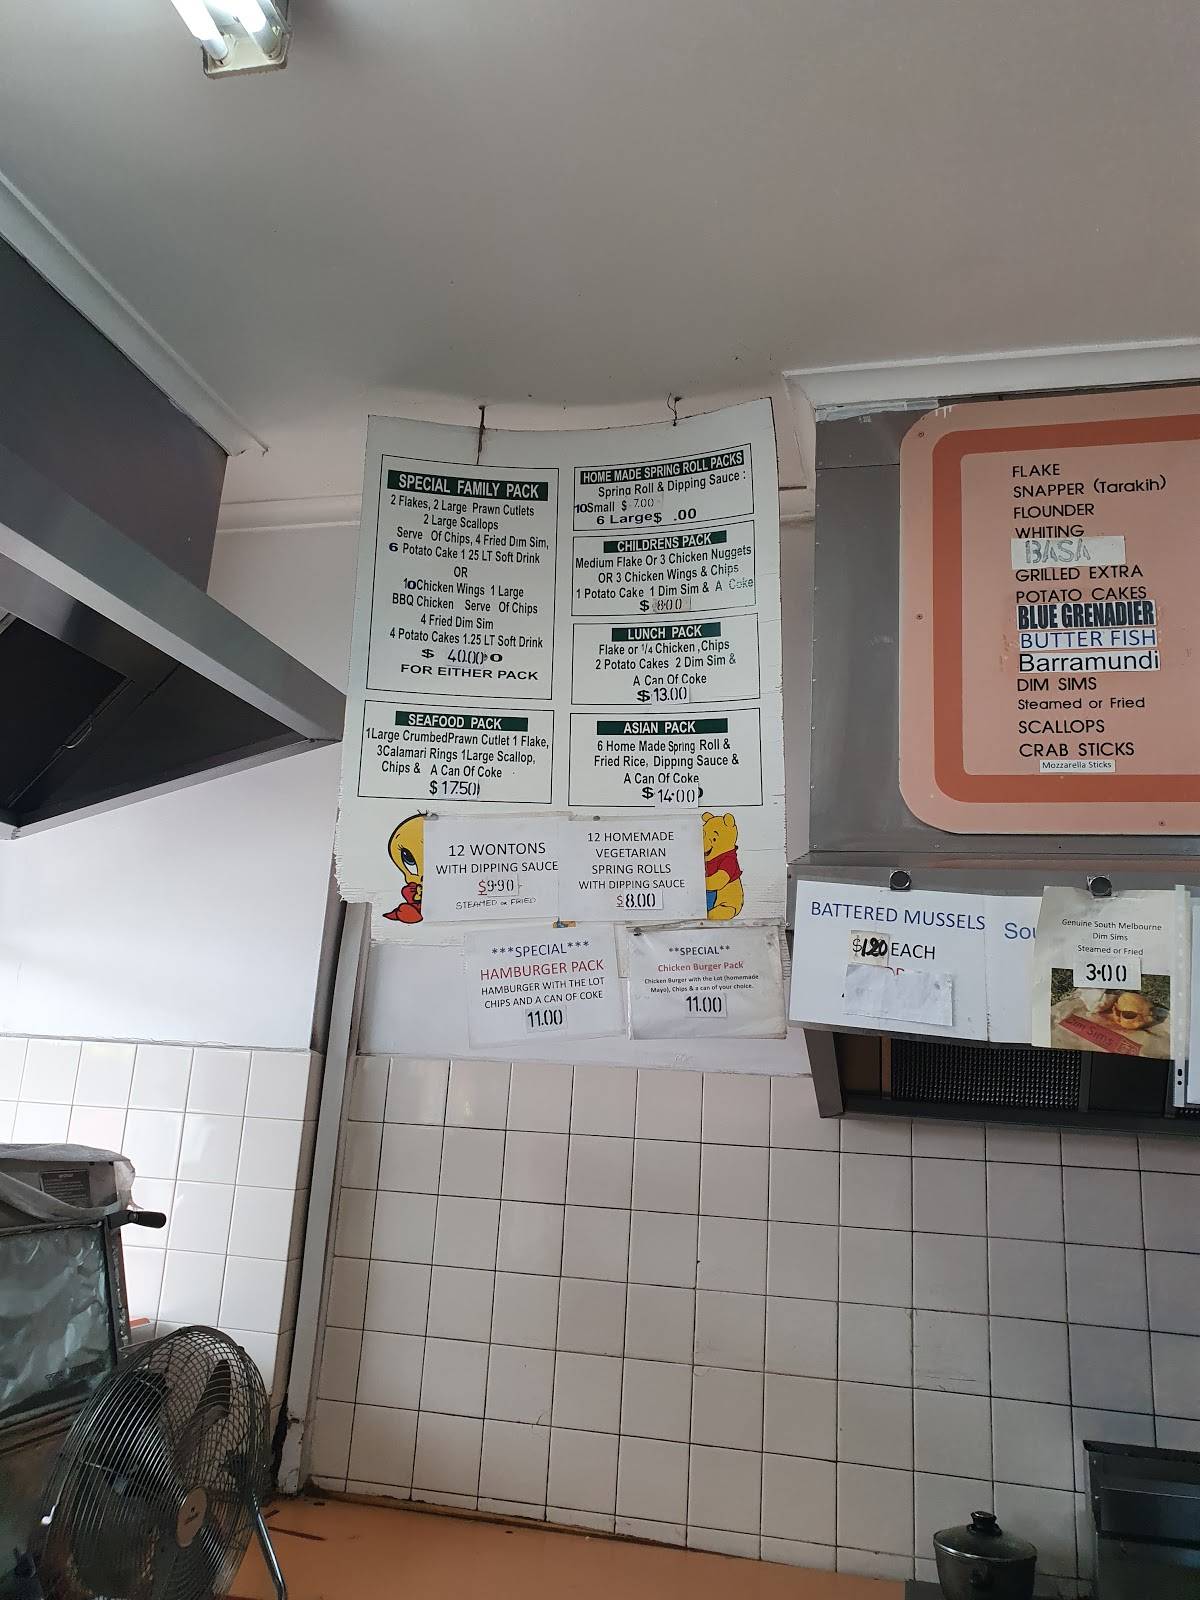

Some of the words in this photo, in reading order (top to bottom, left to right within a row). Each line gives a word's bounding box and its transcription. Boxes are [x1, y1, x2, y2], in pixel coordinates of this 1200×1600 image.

[583, 470, 611, 483] HOME
[614, 468, 642, 480] MADE
[644, 463, 680, 478] SPRING
[682, 459, 708, 472] ROLL
[710, 452, 742, 468] PACKS
[1013, 464, 1060, 478] FLAKE
[399, 473, 450, 493] SPECIAL
[458, 480, 500, 497] FAMILY
[506, 484, 539, 498] PACK
[635, 483, 653, 495] Roll
[668, 476, 705, 492] Dipping
[709, 472, 740, 485] Sauce
[1014, 483, 1084, 498] SNAPPER
[1094, 474, 1166, 494] (Tarakih)
[442, 500, 467, 514] Large
[473, 503, 500, 514] Prawn
[504, 505, 534, 516] Cutlets
[1014, 503, 1094, 519] FLOUNDER
[432, 515, 457, 529] Large
[460, 517, 498, 532] Scallops
[1015, 524, 1084, 538] WHITING
[397, 527, 422, 539] Serve
[445, 532, 472, 546] Chips,
[484, 535, 506, 547] Fried
[510, 536, 526, 548] Dim
[618, 537, 679, 552] CHILDRENS
[682, 533, 712, 546] PACK
[403, 543, 432, 556] Potato
[436, 547, 457, 559] Cake
[495, 550, 513, 562] Soft
[516, 551, 540, 563] Drink
[575, 557, 613, 568] Medium
[617, 557, 642, 567] Flake
[669, 549, 708, 564] Chicken
[711, 545, 752, 559] Nuggets
[1025, 538, 1091, 564] BASA
[625, 570, 664, 582] Chicken
[667, 568, 697, 581] Wings
[711, 563, 739, 576] Chips
[1016, 567, 1080, 582] GRILLED
[1090, 565, 1143, 579] EXTRA
[457, 583, 485, 598] Wings
[499, 586, 524, 599] Large
[585, 588, 616, 599] Potato
[619, 586, 644, 598] Cake
[658, 585, 677, 596] Dim
[681, 583, 699, 595] Sim
[1016, 589, 1082, 603] POTATO
[1092, 586, 1147, 600] CAKES
[392, 593, 414, 606] BBQ
[417, 596, 453, 609] Chicken
[465, 600, 490, 612] Serve
[512, 602, 538, 616] Chips
[429, 615, 452, 627] Fried
[456, 617, 473, 628] Dim
[476, 618, 493, 629] Sim
[1018, 604, 1058, 629] BLUE
[1062, 600, 1154, 627] GRENADIER
[399, 628, 428, 641] Potato
[432, 631, 459, 643] Cakes
[498, 635, 516, 647] Soft
[519, 637, 543, 648] Drink
[628, 628, 665, 640] LUNCH
[672, 625, 702, 638] PACK
[1021, 631, 1102, 648] BUTTER
[1111, 629, 1155, 646] FISH
[599, 644, 625, 655] Flake
[604, 659, 636, 670] Potato
[639, 658, 669, 669] Cakes
[685, 656, 703, 667] Dim
[707, 654, 725, 665] Sim
[1019, 651, 1159, 671] Barramundi
[401, 664, 432, 674] FOR
[438, 666, 492, 678] EITHER
[498, 670, 538, 680] PACK
[645, 674, 663, 686] Can
[682, 673, 707, 684] Coke
[1018, 679, 1048, 691] DIM
[1058, 677, 1097, 690] SIMS
[1018, 698, 1082, 709] Steamed
[1111, 697, 1145, 708] Fried
[408, 714, 464, 727] SEAFOOD
[471, 717, 501, 729] PACK
[624, 722, 658, 733] ASIAN
[665, 721, 696, 733] PACK
[1019, 720, 1104, 733] SCALLOPS
[481, 734, 509, 746] Cutlet
[521, 736, 549, 748] Flake,
[606, 741, 635, 751] Home
[639, 740, 665, 751] Made
[668, 740, 695, 754] Spring
[700, 739, 720, 750] Roll
[430, 748, 457, 762] Rings
[1020, 743, 1068, 757] CRAB
[1079, 742, 1134, 756] STICKS
[382, 761, 410, 774] Chips
[441, 765, 459, 776] Can
[478, 766, 502, 778] Coke
[595, 756, 620, 766] Fried
[653, 756, 693, 769] Dipping
[697, 755, 728, 766] Sauce
[1089, 761, 1111, 769] Sticks
[635, 773, 654, 784] Can
[673, 772, 699, 783] Coke
[604, 832, 674, 841] HOMEMADE
[449, 845, 465, 856] 12
[470, 842, 545, 855] WONTONS
[596, 848, 666, 858] VEGETARIAN
[436, 864, 467, 874] WITH
[472, 863, 518, 873] DIPPING
[522, 861, 559, 871] SAUCE
[592, 864, 633, 874] SPRING
[638, 864, 671, 873] ROLLS
[579, 881, 605, 889] WITH
[609, 880, 649, 889] DIPPING
[653, 880, 685, 888] SAUCE
[456, 900, 497, 909] STEAMED
[812, 902, 897, 922] BATTERED
[905, 910, 985, 930] MUSSELS
[1062, 919, 1092, 928] Genuine
[1095, 921, 1116, 929] South
[1119, 922, 1162, 931] Melbourne
[892, 943, 935, 959] EACH
[1078, 945, 1111, 953] Steamed
[480, 963, 566, 980] HAMBURGER
[572, 960, 604, 972] PACK
[658, 964, 690, 972] Chicken
[694, 963, 721, 971] Burger
[482, 983, 540, 995] HAMBURGER
[542, 980, 566, 990] WITH
[484, 999, 510, 1008] CHIPS
[513, 997, 532, 1006] AND
[544, 994, 562, 1003] CAN
[580, 991, 603, 1000] COKE
[686, 996, 722, 1012] 11.00
[528, 1010, 562, 1028] 11.00
